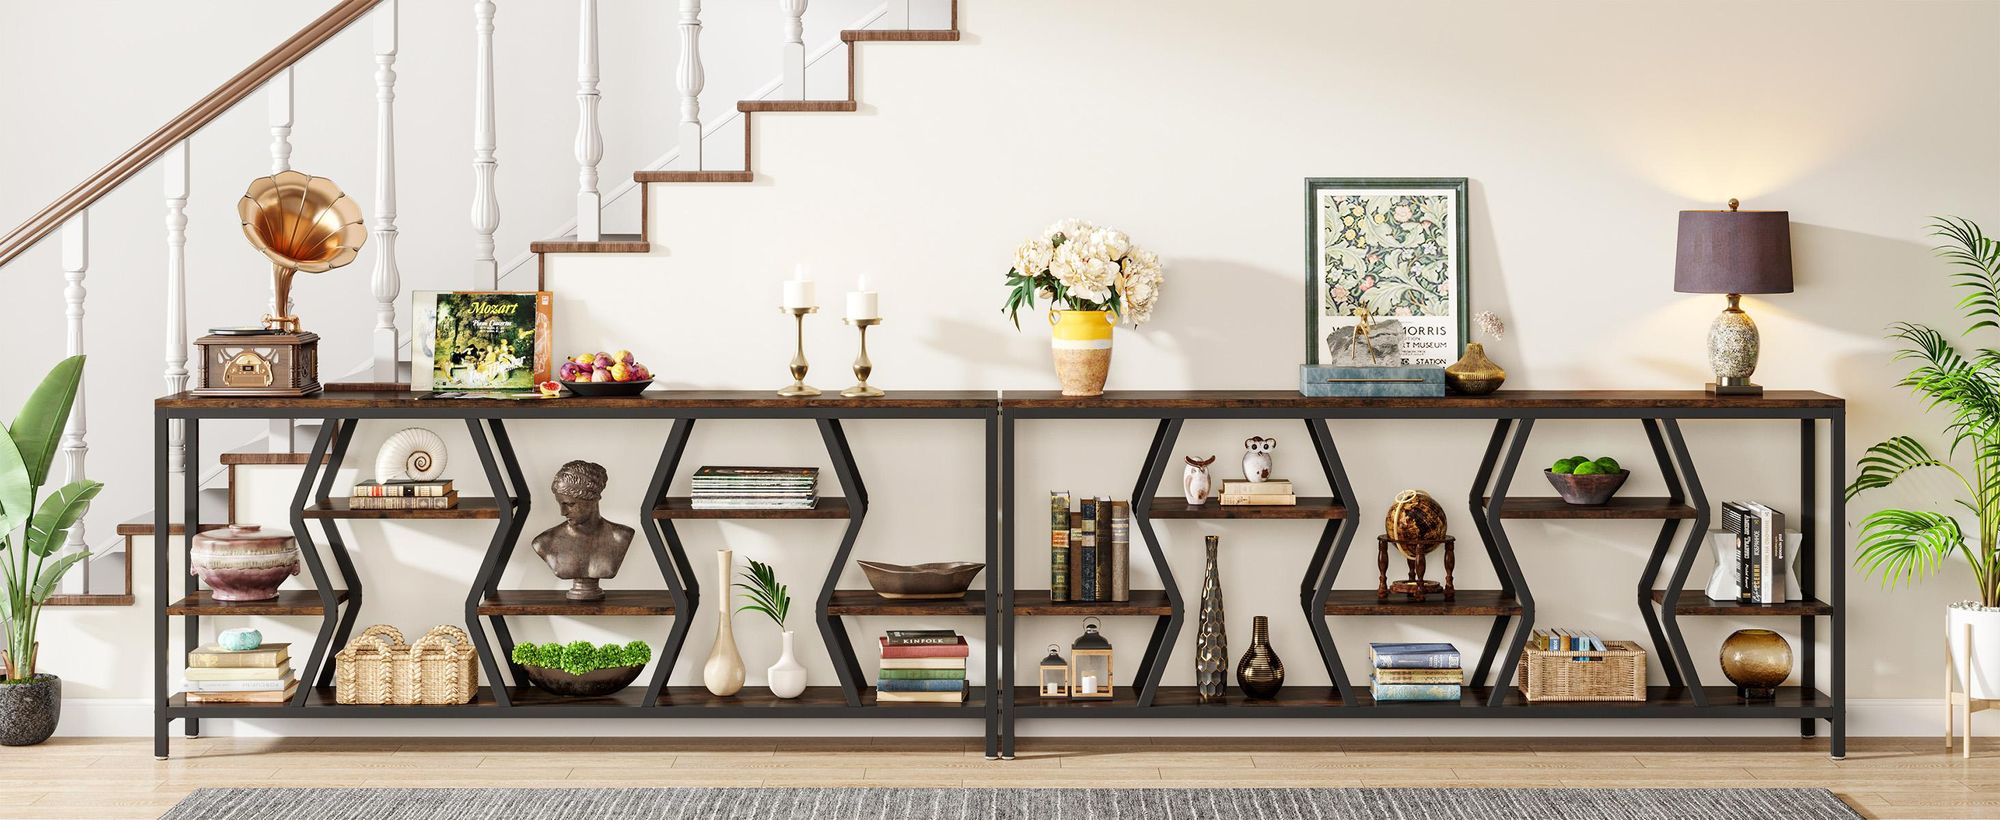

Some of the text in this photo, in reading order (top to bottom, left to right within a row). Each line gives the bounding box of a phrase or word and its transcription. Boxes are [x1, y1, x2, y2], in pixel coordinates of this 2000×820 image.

[467, 301, 519, 314] Mozart
[1412, 341, 1447, 349] MUSEUM
[1415, 358, 1447, 366] STATION
